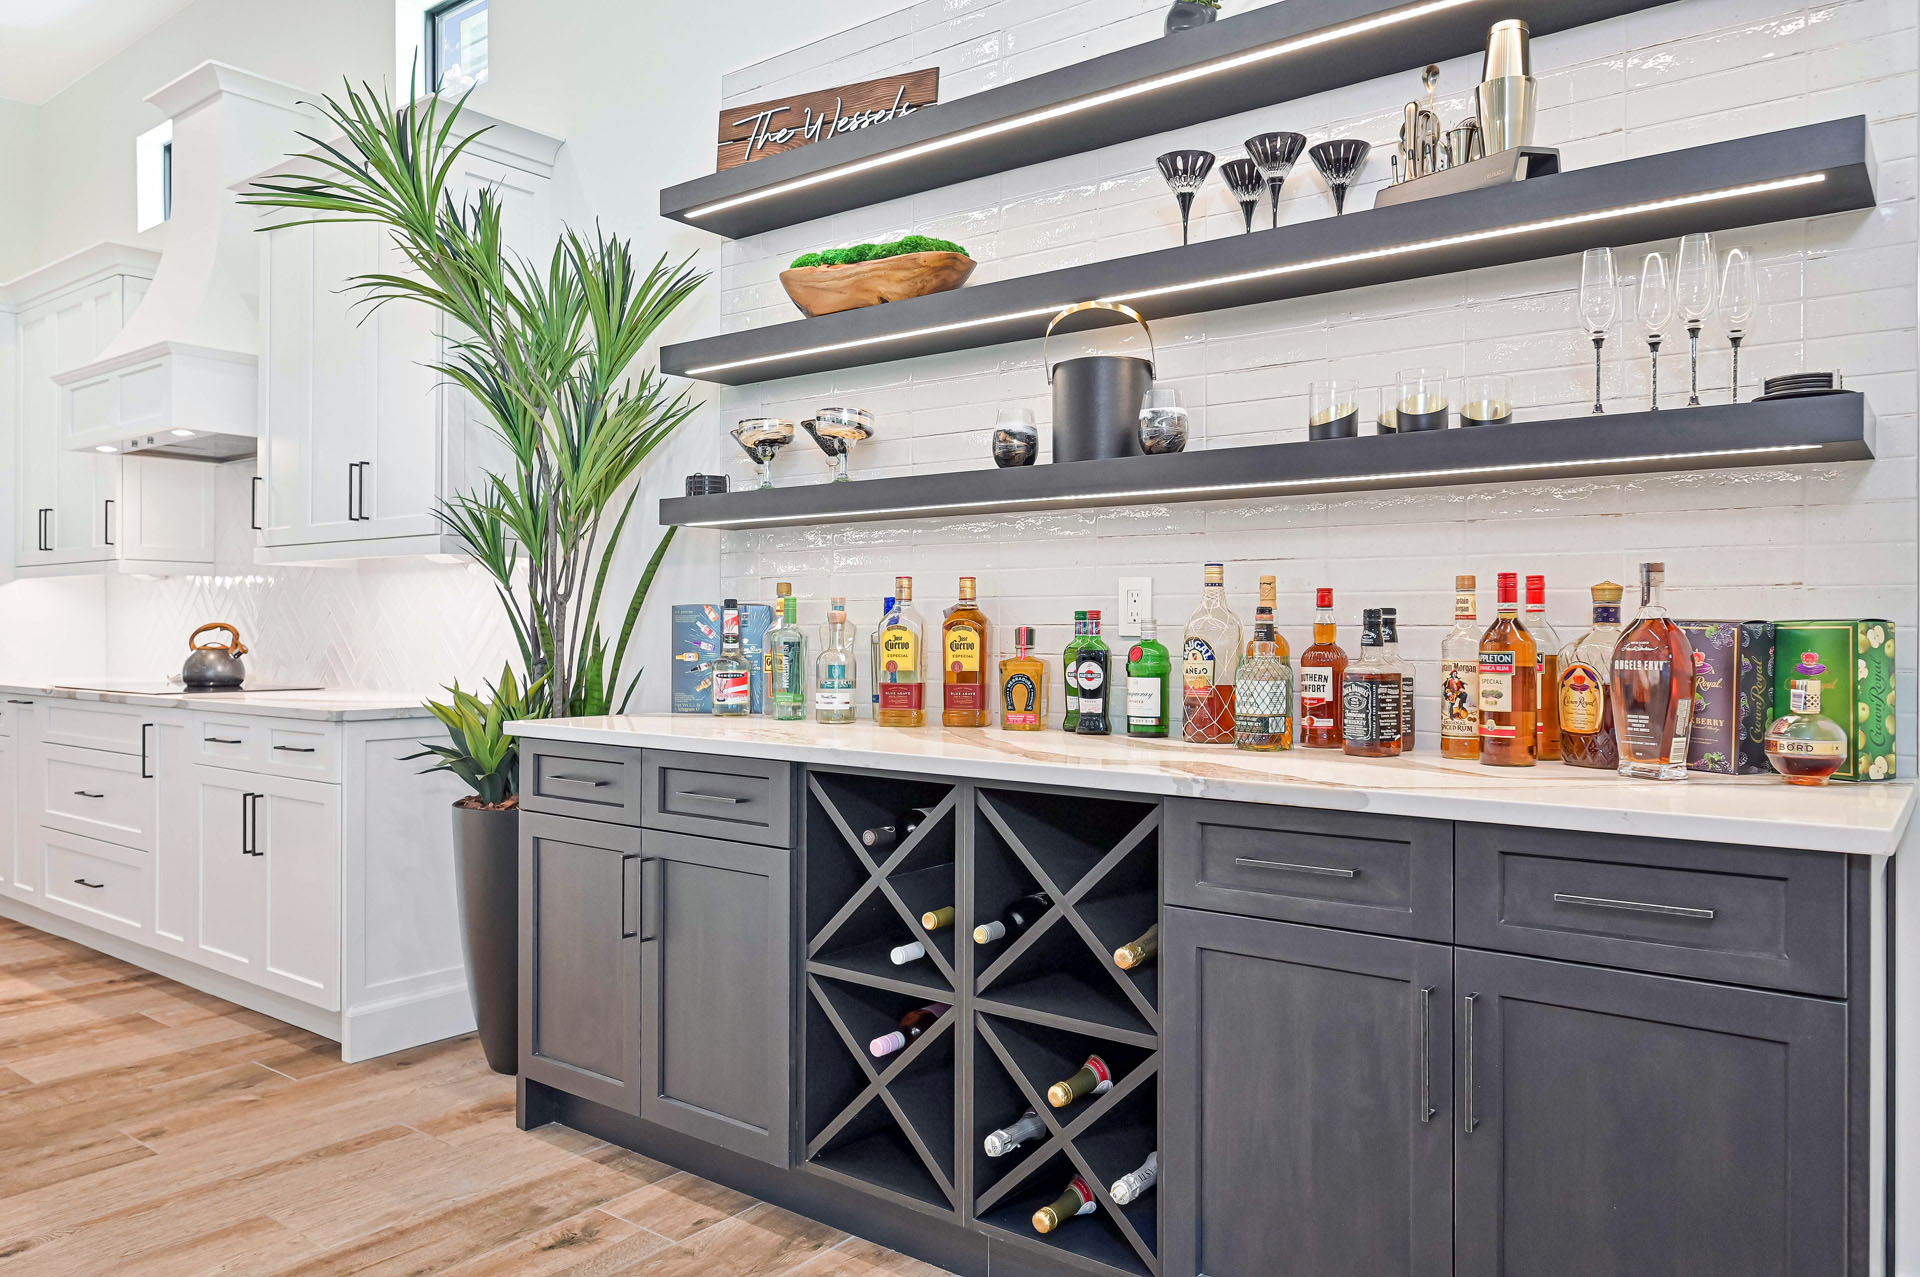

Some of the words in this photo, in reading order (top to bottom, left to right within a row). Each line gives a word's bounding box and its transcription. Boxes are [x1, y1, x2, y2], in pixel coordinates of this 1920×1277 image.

[732, 106, 795, 160] The
[804, 85, 917, 143] Wessels
[885, 639, 910, 652] Cuervo
[949, 640, 975, 652] Cuervo
[1750, 655, 1767, 706] Royal
[1869, 658, 1887, 704] Royal
[1695, 717, 1725, 727] BERRY
[1750, 701, 1764, 743] Crown
[1870, 702, 1886, 747] Crown
